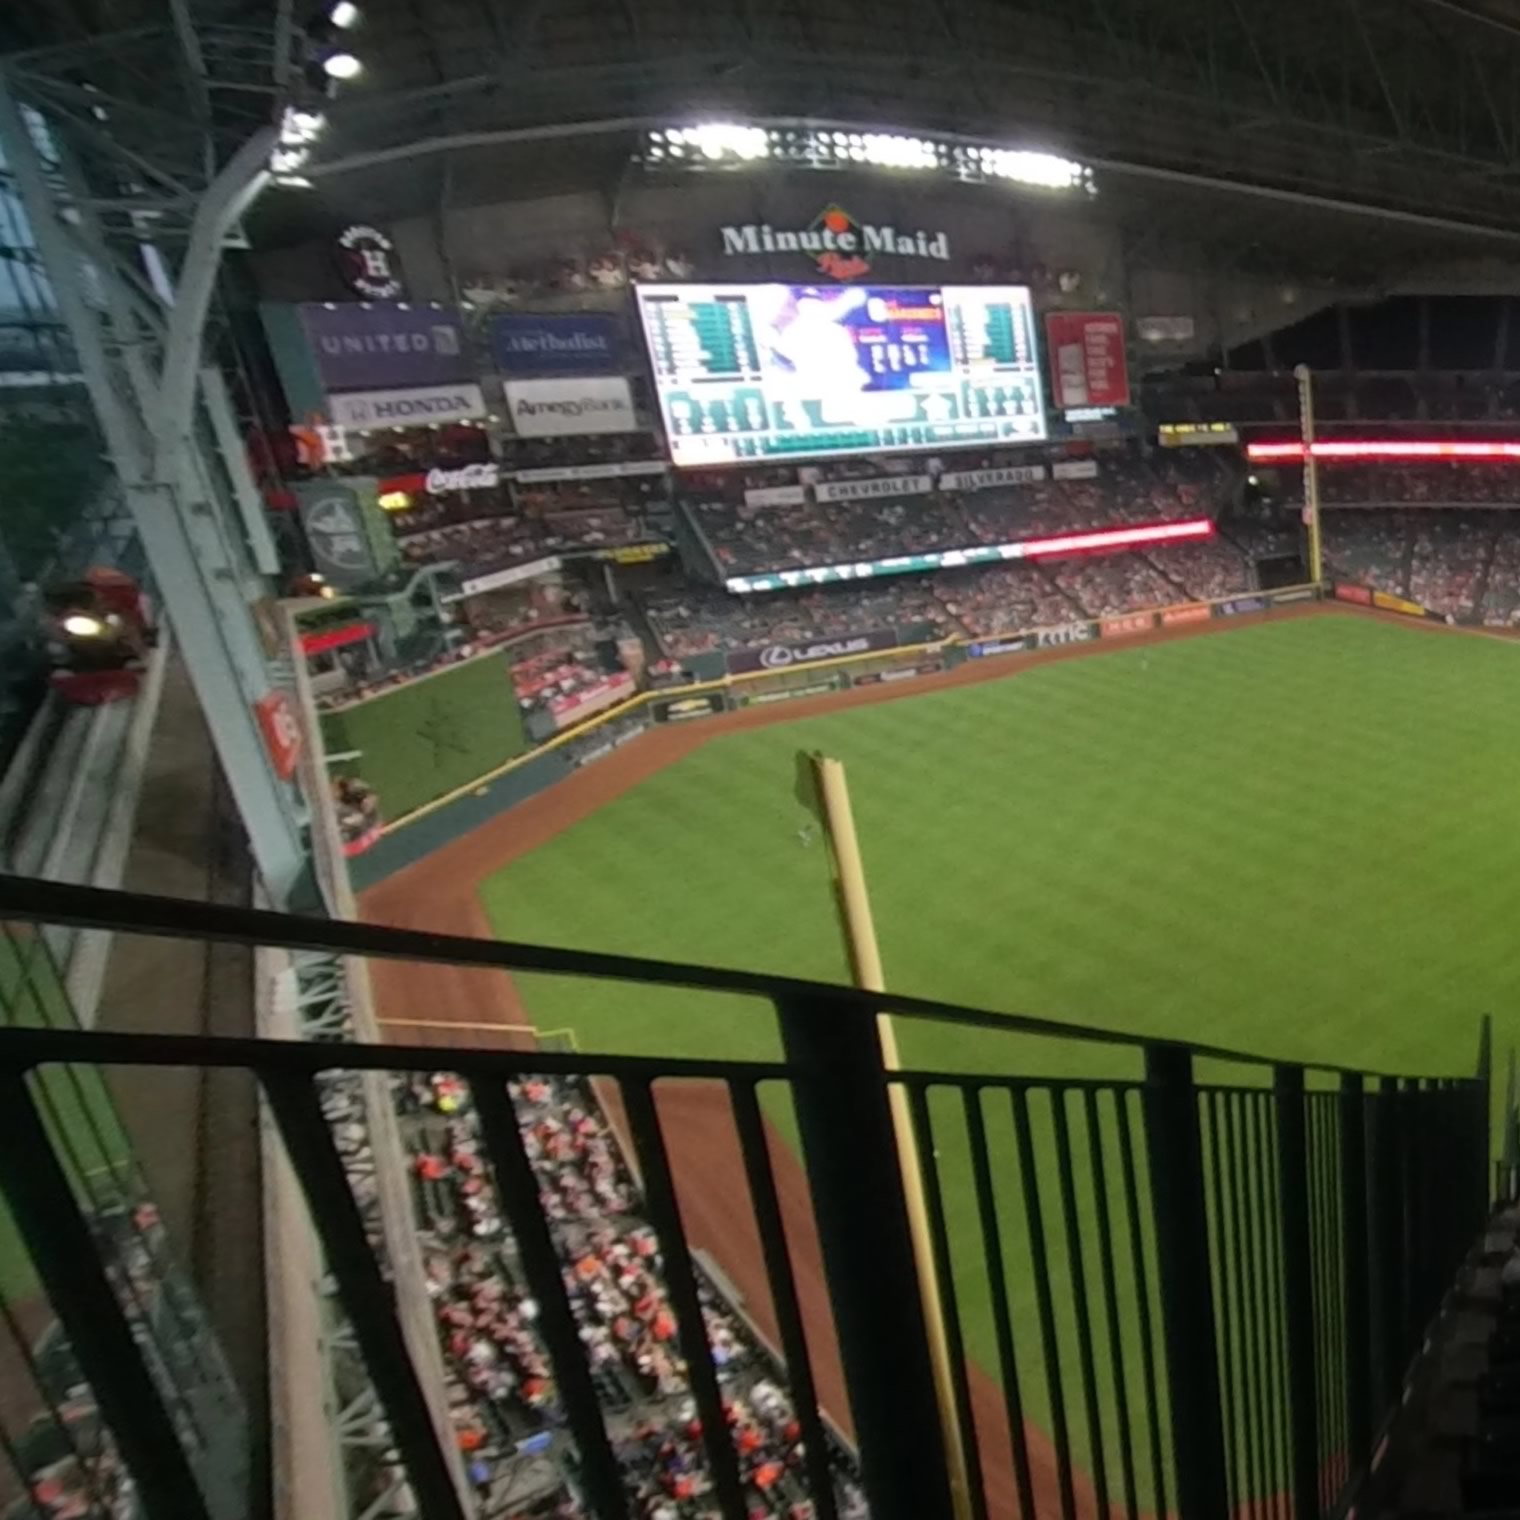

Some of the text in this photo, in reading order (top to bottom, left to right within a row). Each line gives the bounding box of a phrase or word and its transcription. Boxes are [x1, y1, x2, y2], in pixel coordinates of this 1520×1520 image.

[721, 225, 949, 260] Minute Maid
[321, 332, 430, 353] UNITED
[374, 395, 472, 418] HONDA
[827, 479, 920, 498] CHEVROLET
[956, 469, 1033, 489] SILVERADO
[793, 638, 869, 660] LEXUS
